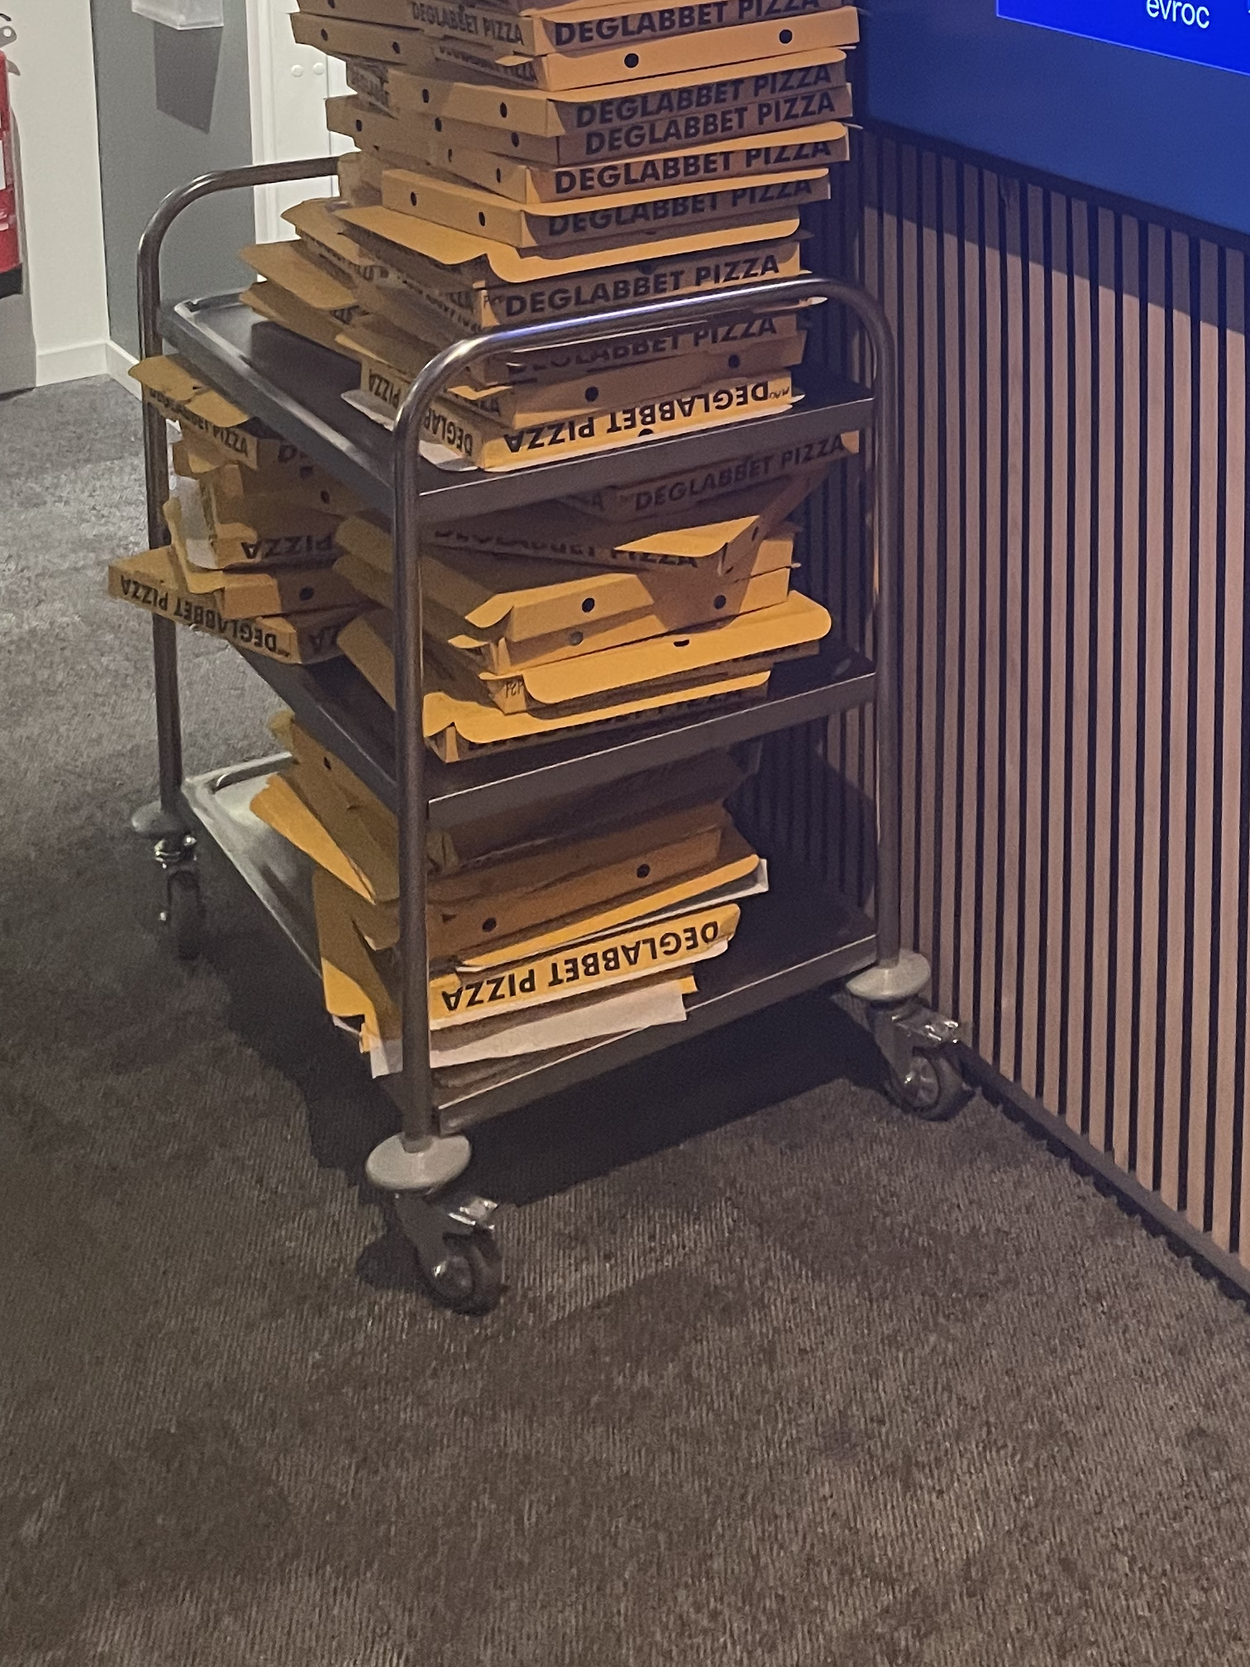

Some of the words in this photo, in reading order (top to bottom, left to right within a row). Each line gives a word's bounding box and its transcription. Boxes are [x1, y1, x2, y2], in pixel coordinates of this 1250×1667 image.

[410, 0, 479, 34] DEGLABBET
[483, 16, 525, 46] PIZZA
[554, 1, 729, 47] DEGLABBET
[576, 78, 748, 129] DEGLABBET
[753, 65, 832, 96] PIZZA
[585, 107, 749, 156] DEGLABBET
[758, 92, 836, 126] PIZZA
[555, 151, 735, 195] DEGLABBET
[745, 141, 832, 168] PIZZA
[549, 192, 719, 236] DEGLABBET
[731, 180, 813, 208] PIZZA
[505, 269, 685, 318] DEGLABBET
[694, 254, 780, 287] PIZZA
[368, 368, 401, 410] PIZZA
[606, 381, 769, 433] DEGLABBET
[503, 416, 595, 453] PIZZA
[634, 454, 775, 512] DEGLABBET
[780, 432, 844, 468] PIZZA
[120, 574, 169, 612] PIZZA
[173, 592, 277, 653] DEGLABBET
[547, 921, 719, 987] DEGLABBET
[441, 968, 536, 1011] PIZZA
